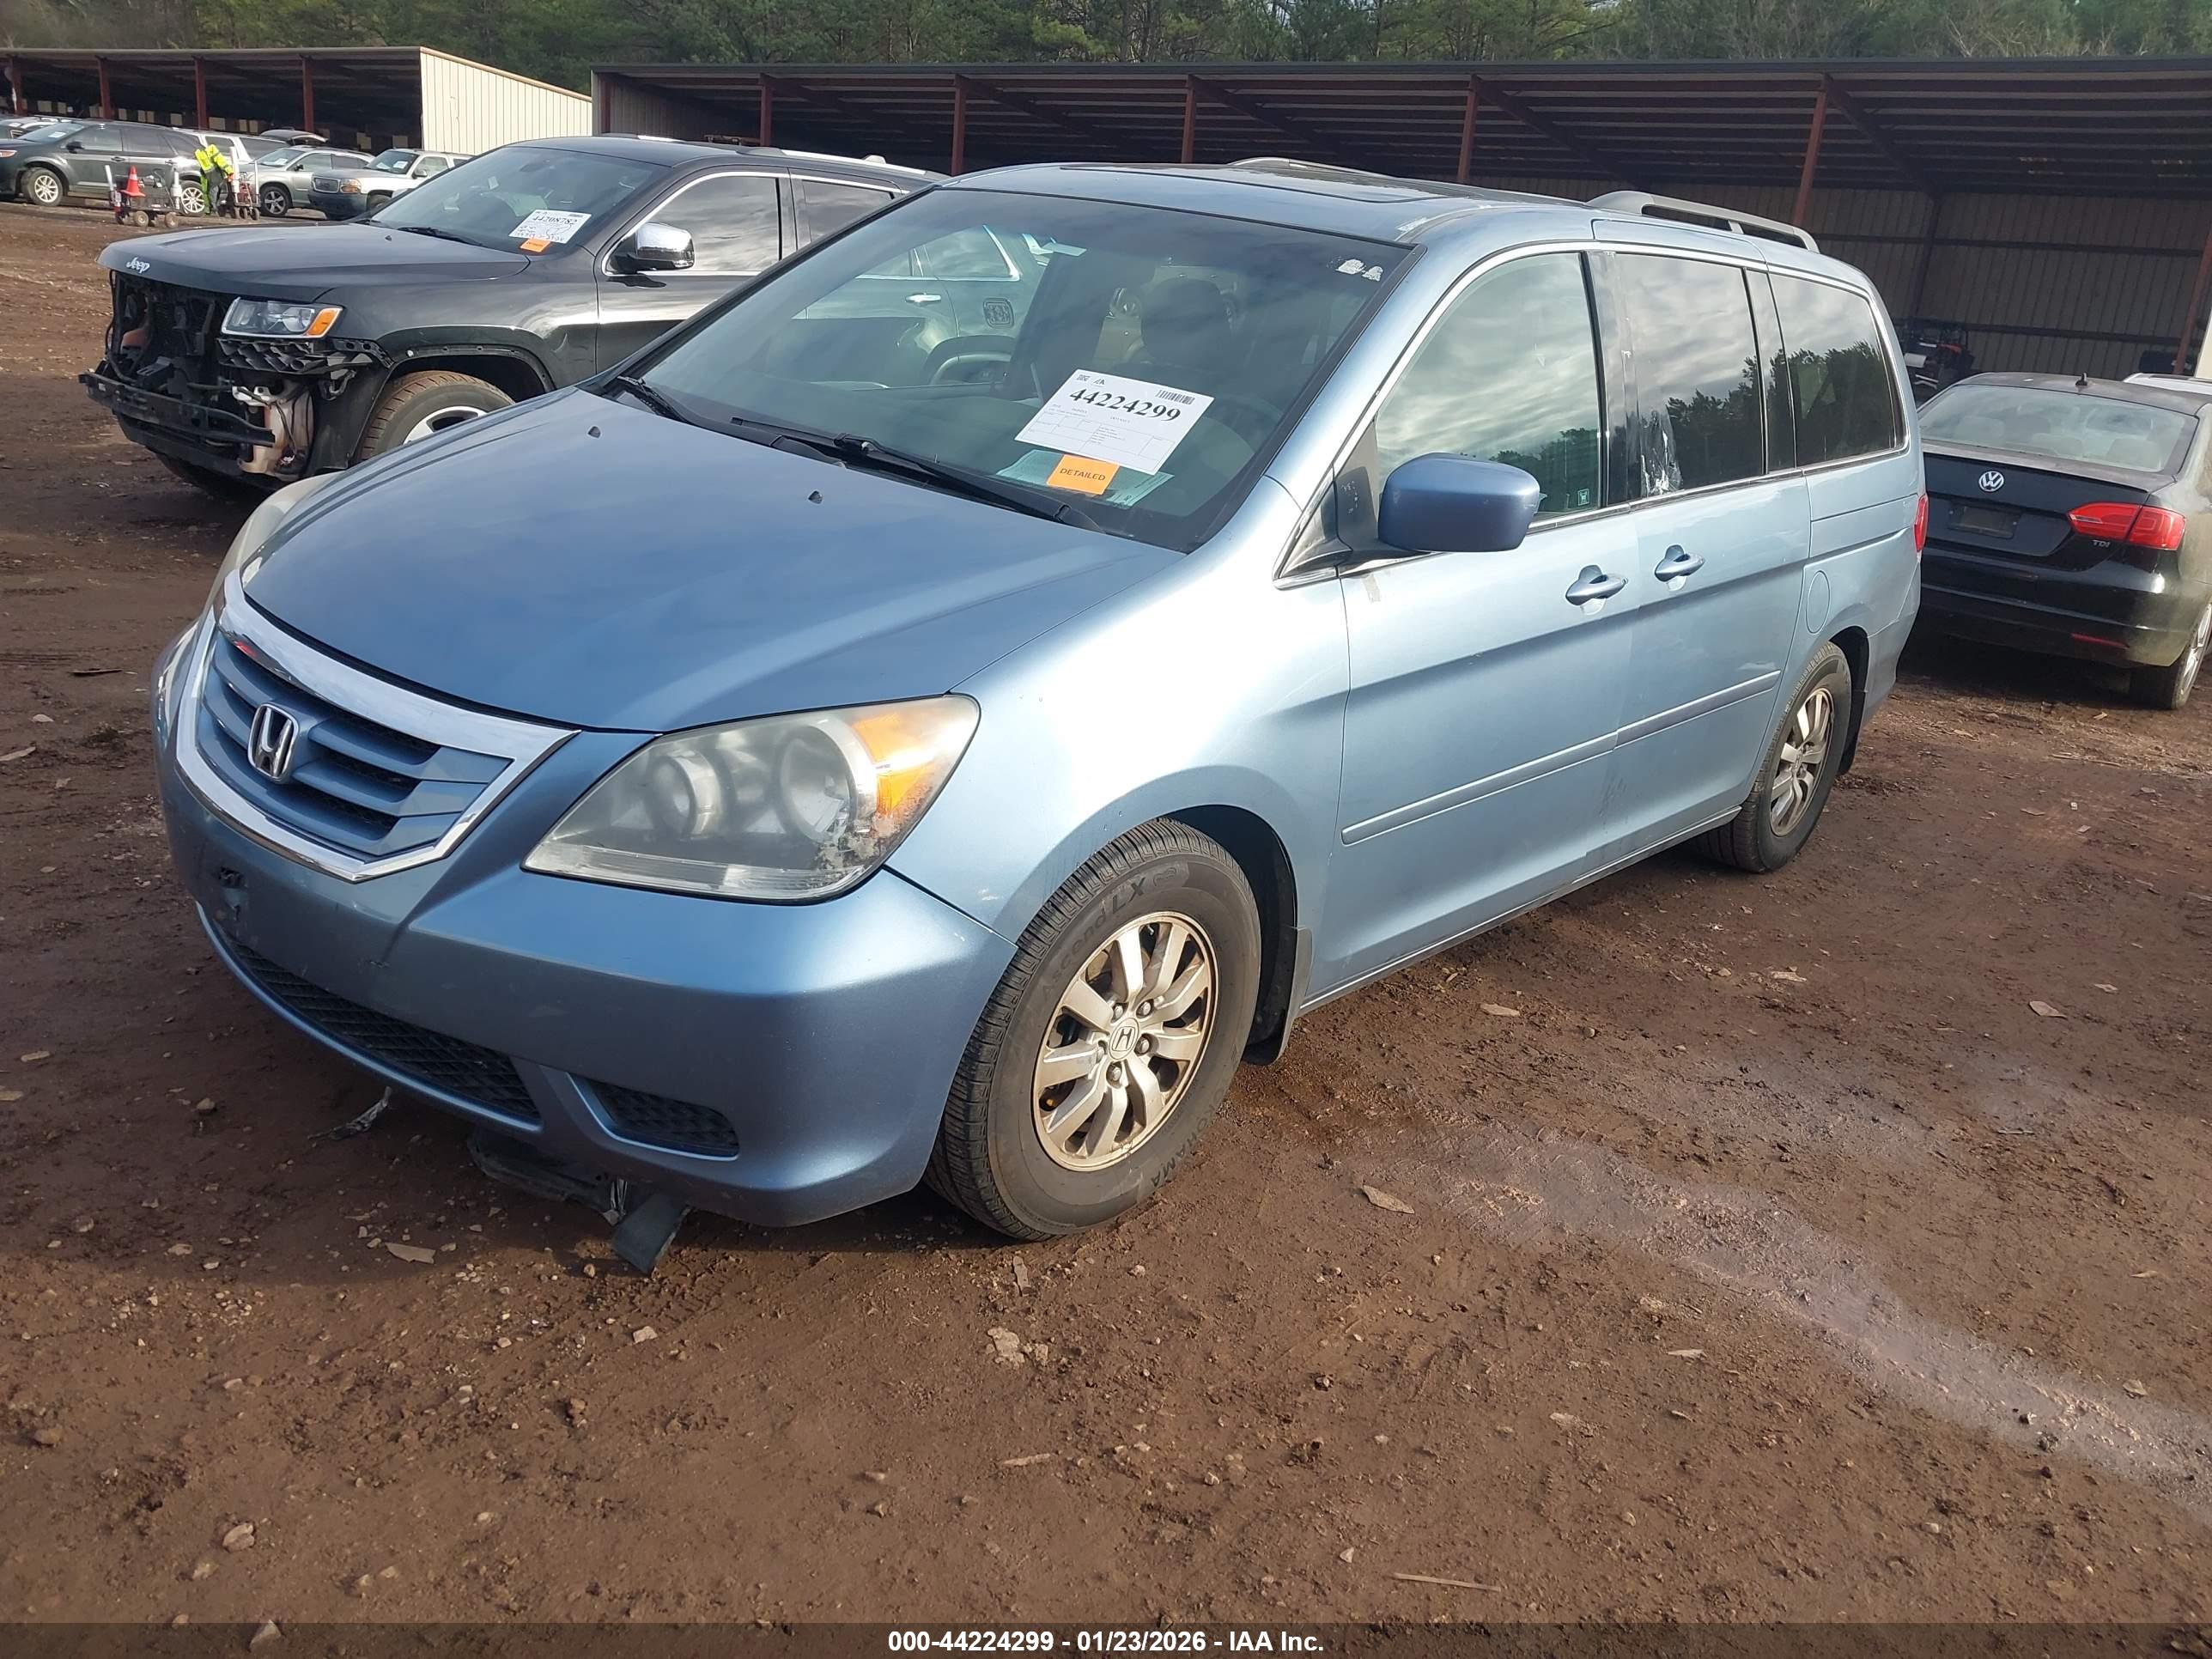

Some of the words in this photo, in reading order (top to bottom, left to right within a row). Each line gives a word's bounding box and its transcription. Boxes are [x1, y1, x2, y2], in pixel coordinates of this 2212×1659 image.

[126, 257, 150, 273] Jeep
[1068, 388, 1182, 422] 44224299
[1060, 467, 1106, 482] DETAILED
[2093, 539, 2111, 549] TDI
[1112, 877, 1146, 914] LX
